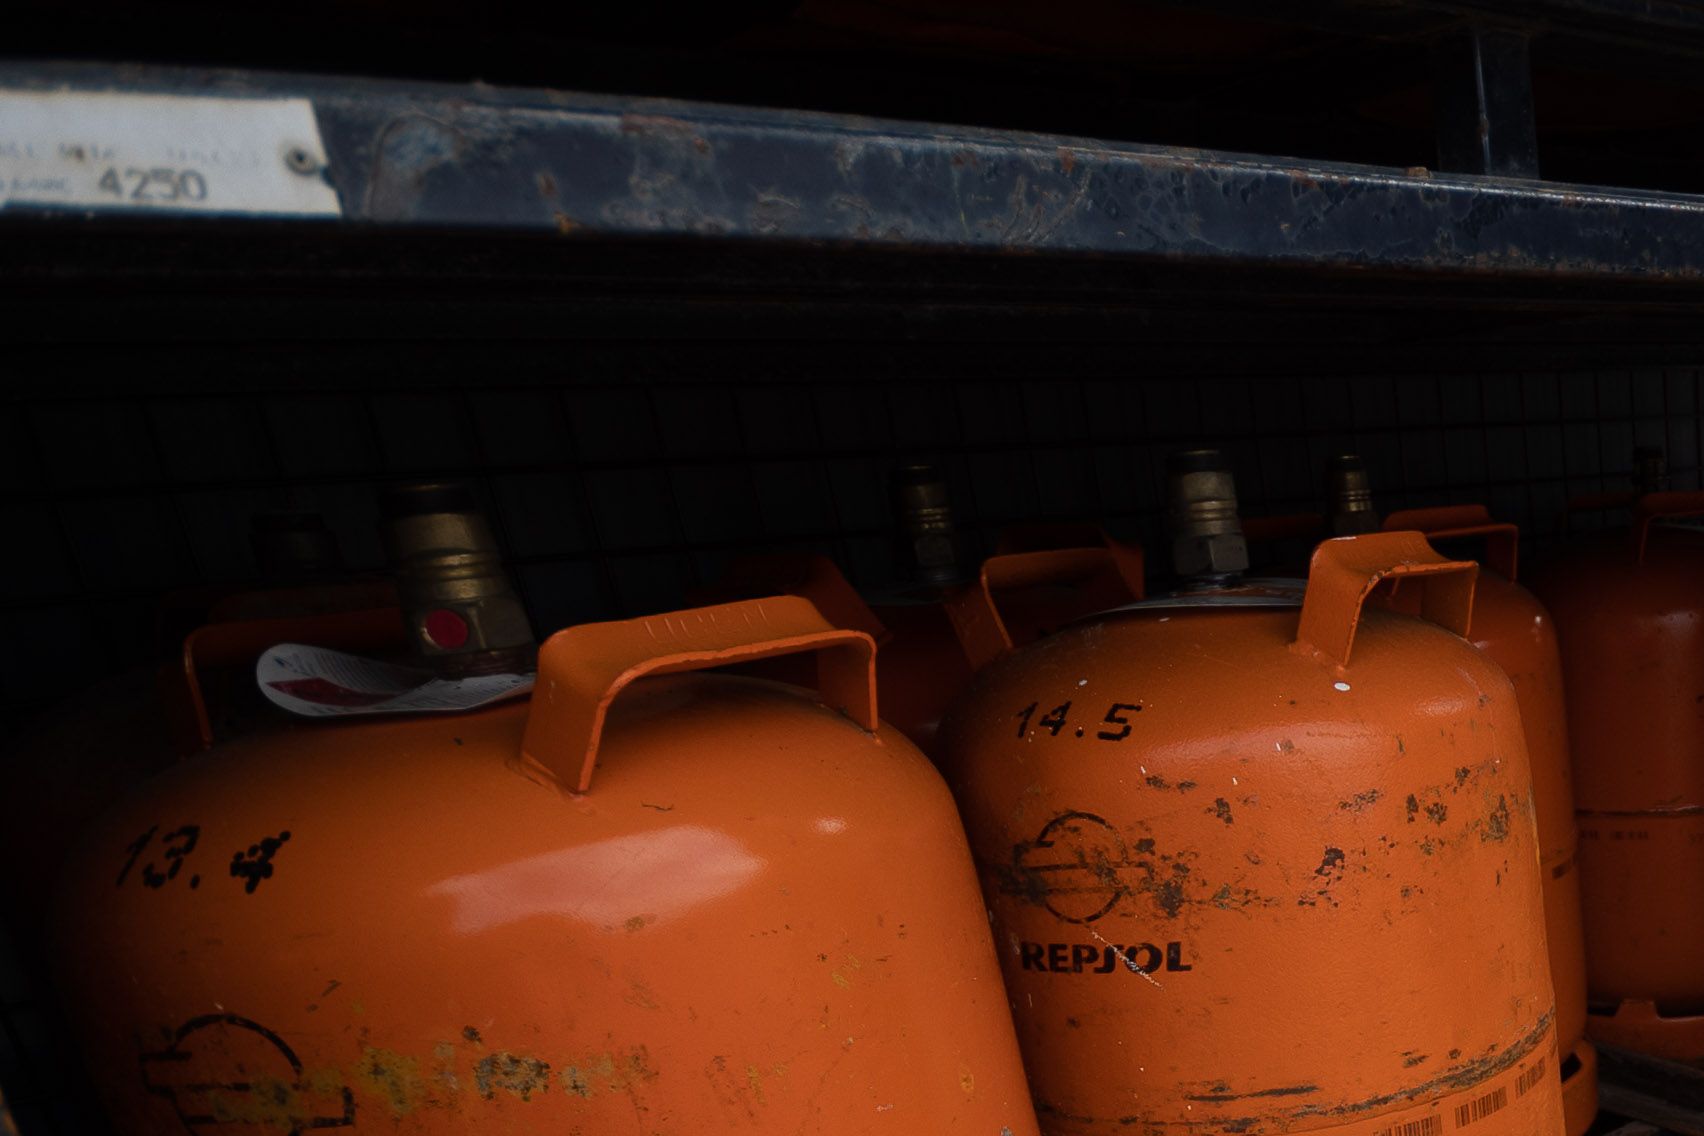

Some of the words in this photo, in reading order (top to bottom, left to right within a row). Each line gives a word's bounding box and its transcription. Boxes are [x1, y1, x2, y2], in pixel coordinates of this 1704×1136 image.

[1016, 701, 1143, 741] 14.5
[115, 825, 291, 894] 13.4
[1020, 941, 1192, 974] REPSOL
